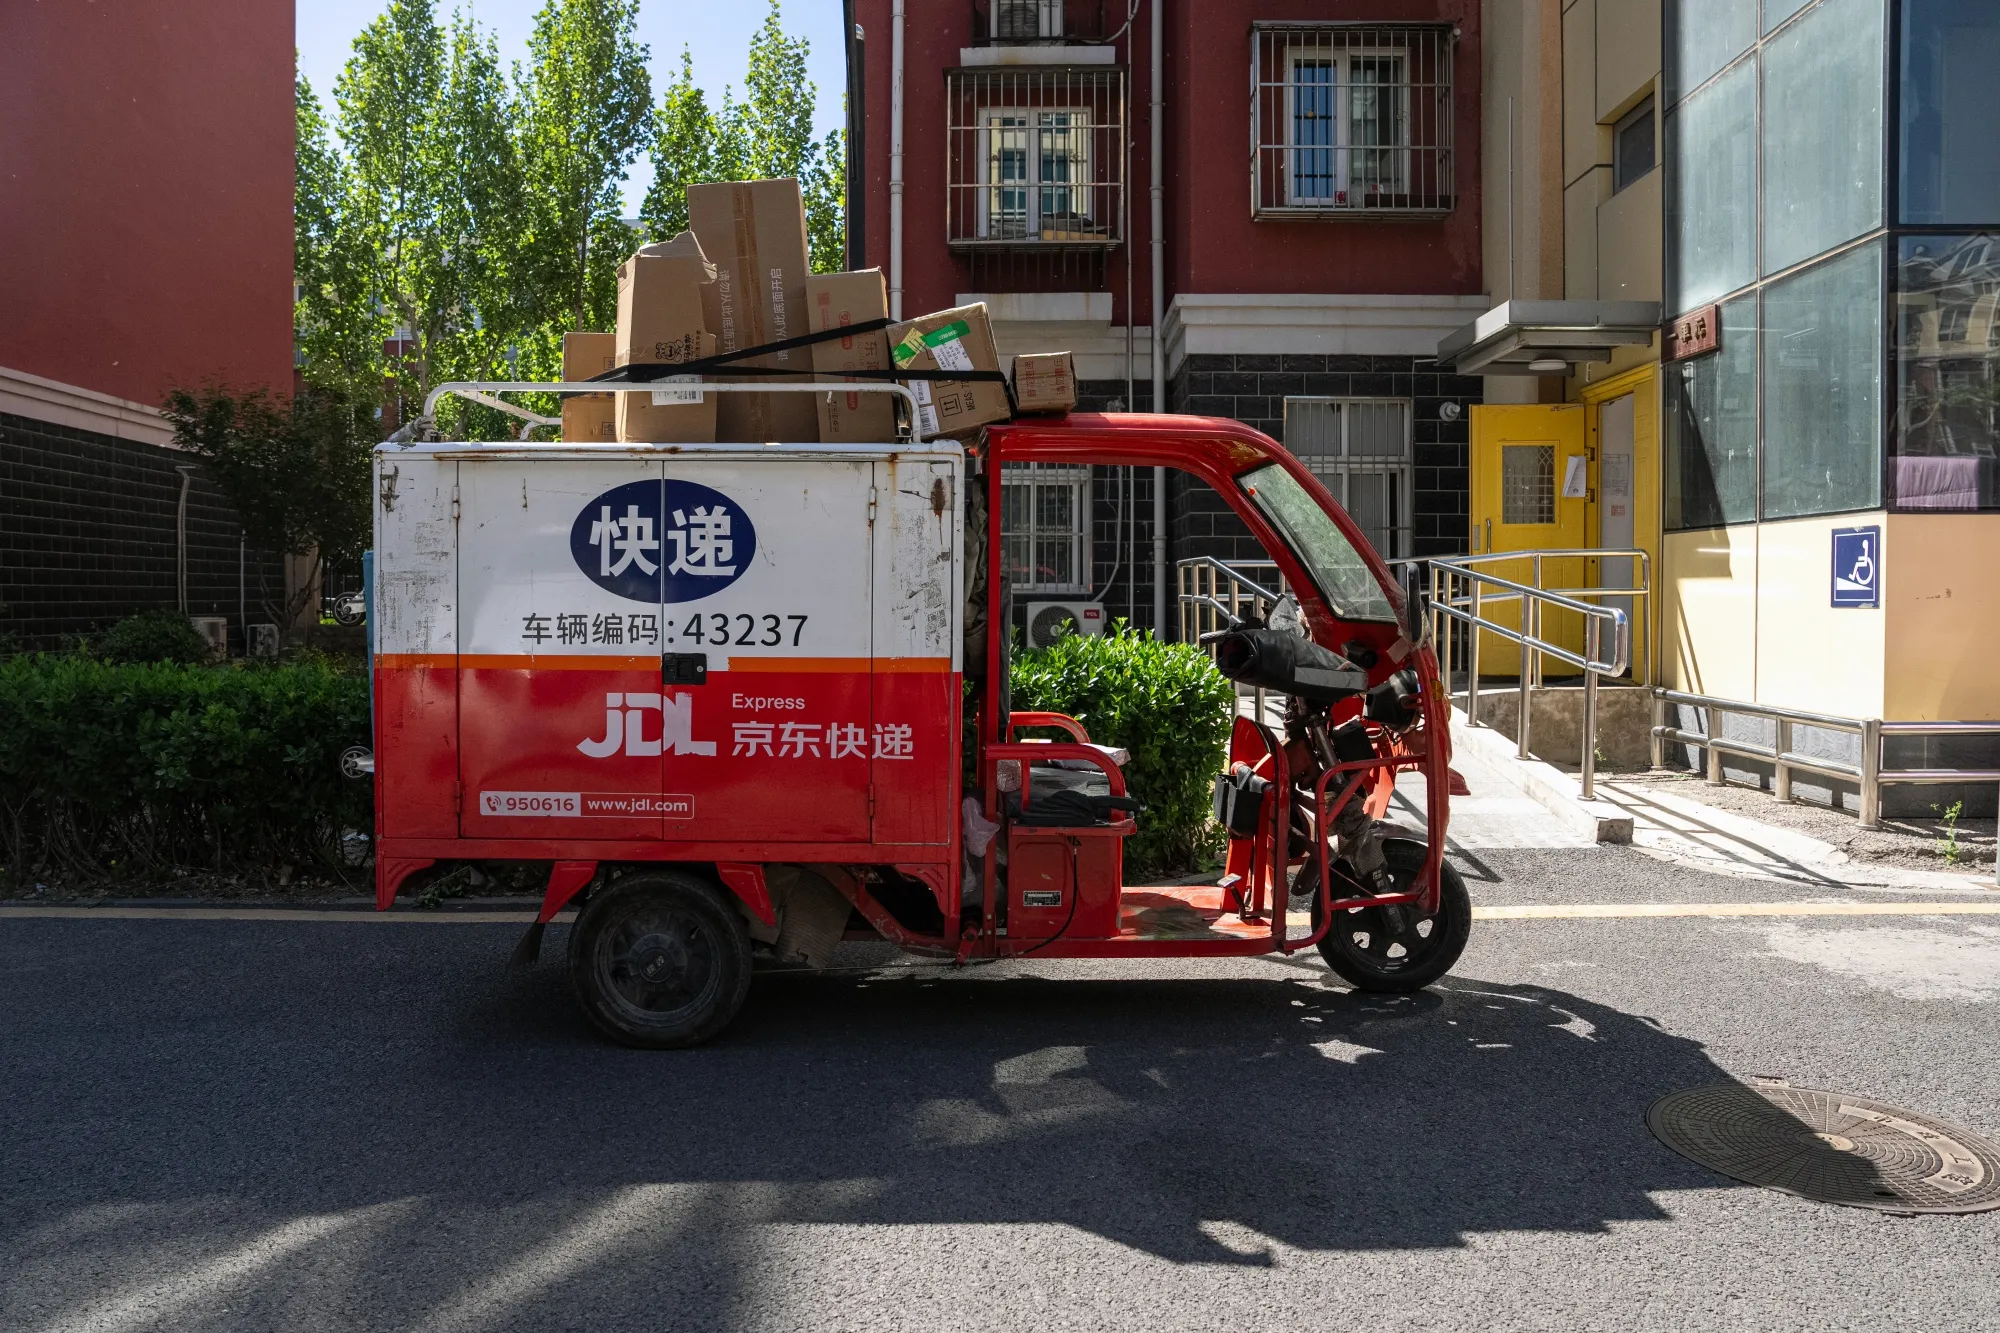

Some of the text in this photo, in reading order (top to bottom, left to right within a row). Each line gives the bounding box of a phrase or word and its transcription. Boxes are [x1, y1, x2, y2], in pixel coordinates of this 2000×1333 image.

[770, 268, 788, 361] 请从此底面开启
[589, 505, 737, 577] 快递
[522, 612, 809, 647] 车辆编码:43237
[732, 693, 806, 711] Express
[576, 691, 717, 757] JDL
[731, 720, 915, 761] 京东快递
[506, 797, 575, 812] 950616
[587, 797, 688, 813] www.jdl.com
